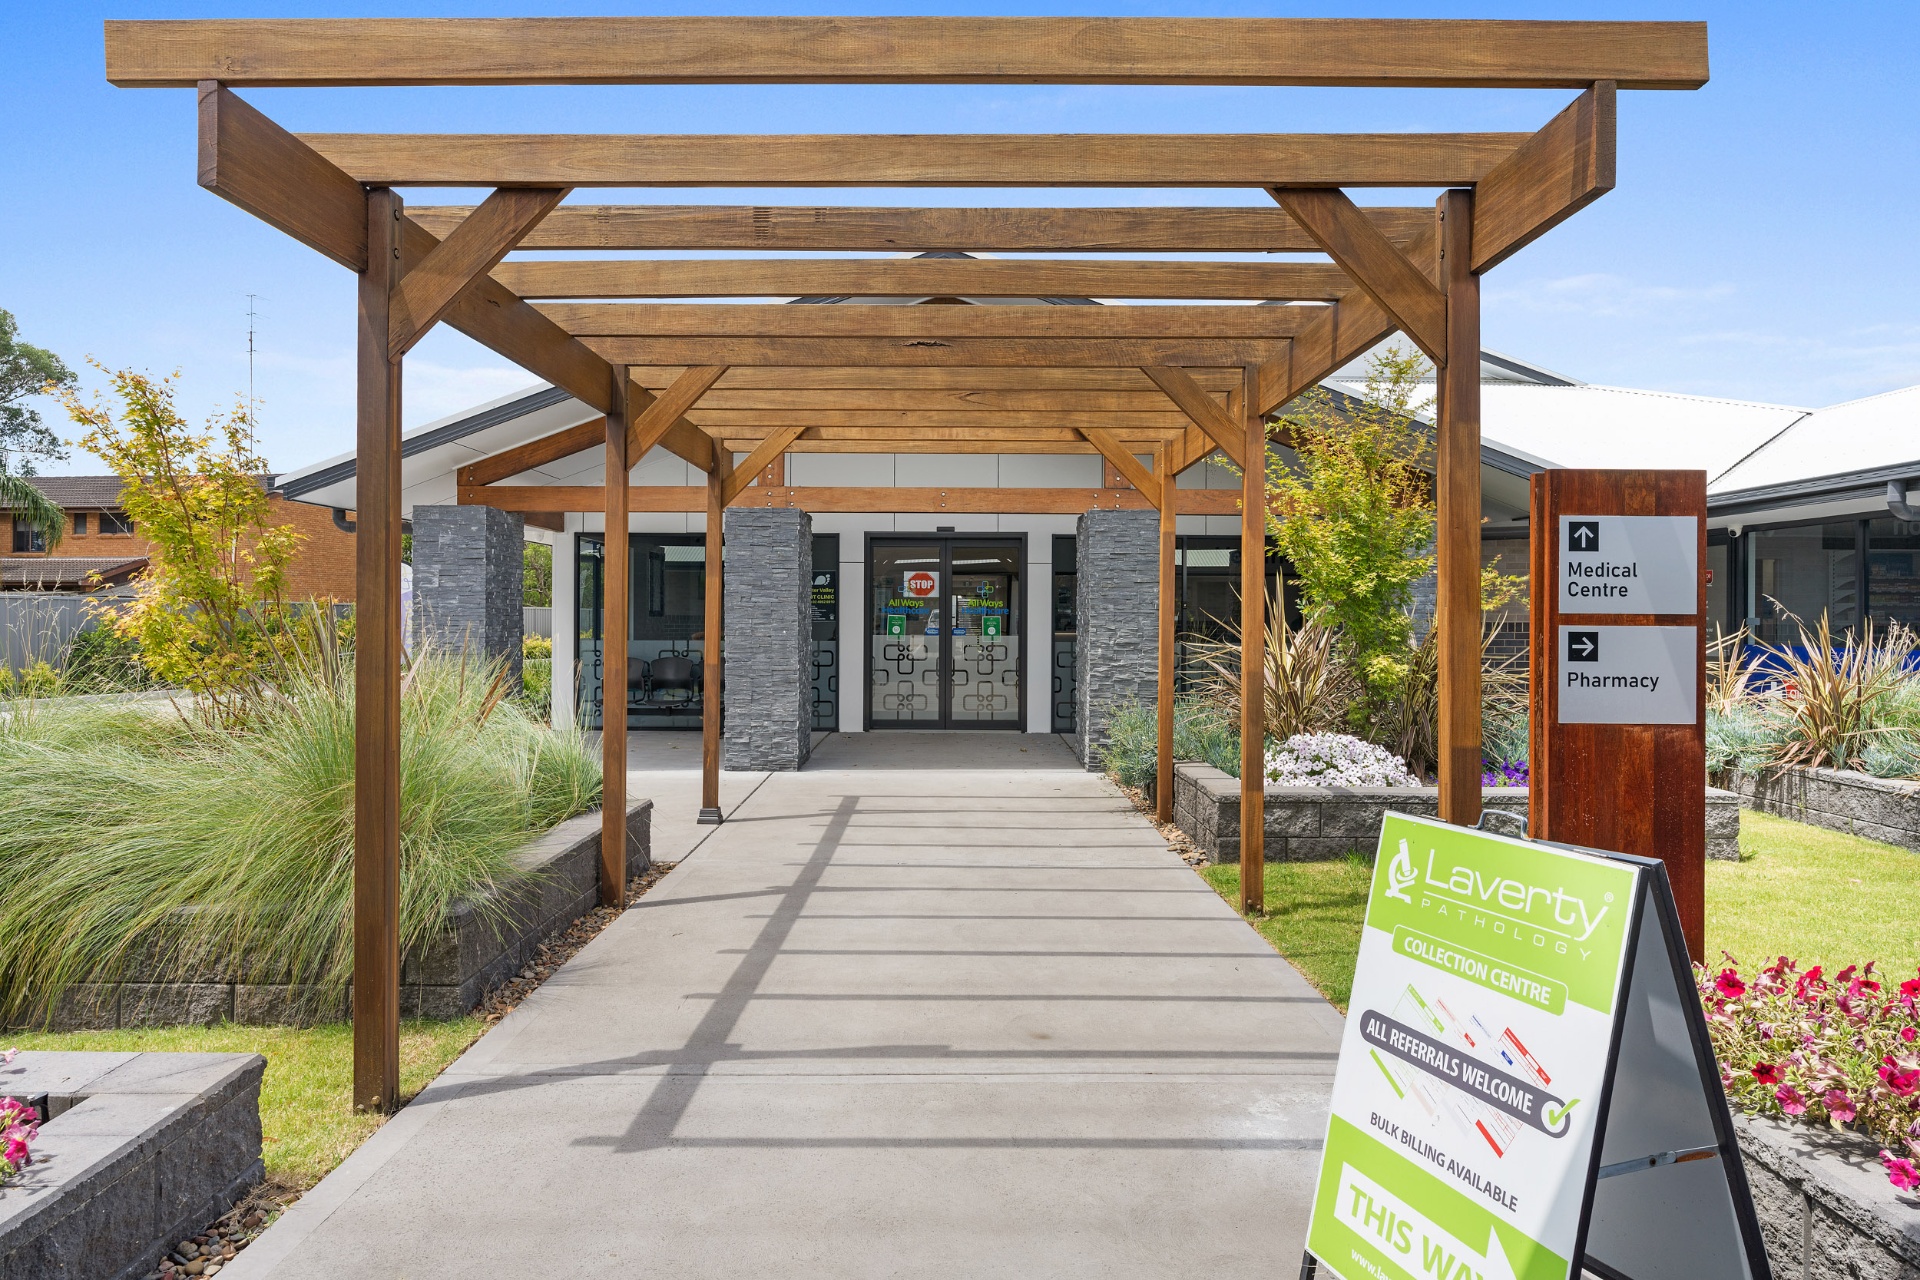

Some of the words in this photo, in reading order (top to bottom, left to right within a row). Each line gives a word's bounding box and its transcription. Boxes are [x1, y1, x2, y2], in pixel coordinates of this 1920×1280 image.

[1568, 562, 1637, 578] Medical
[909, 580, 934, 589] STOP
[1568, 581, 1628, 597] Centre
[888, 599, 900, 607] All
[900, 599, 924, 608] Ways
[962, 607, 1009, 615] Healthcare
[968, 599, 979, 607] All
[979, 599, 1003, 608] Ways
[1567, 672, 1659, 692] Pharmacy
[1425, 849, 1609, 941] Laverty
[1421, 898, 1592, 961] PATHOLOGY
[1404, 936, 1487, 981] COLLECTION
[1490, 968, 1551, 1006] CENTRE
[1366, 1018, 1387, 1042] ALL
[1389, 1028, 1459, 1077] REFERRALS
[1462, 1063, 1533, 1115] WELCOME
[1370, 1112, 1400, 1140] BULK
[1400, 1129, 1446, 1168] BILLING
[1446, 1159, 1519, 1213] AVAILABLE
[1350, 1183, 1413, 1255] THIS
